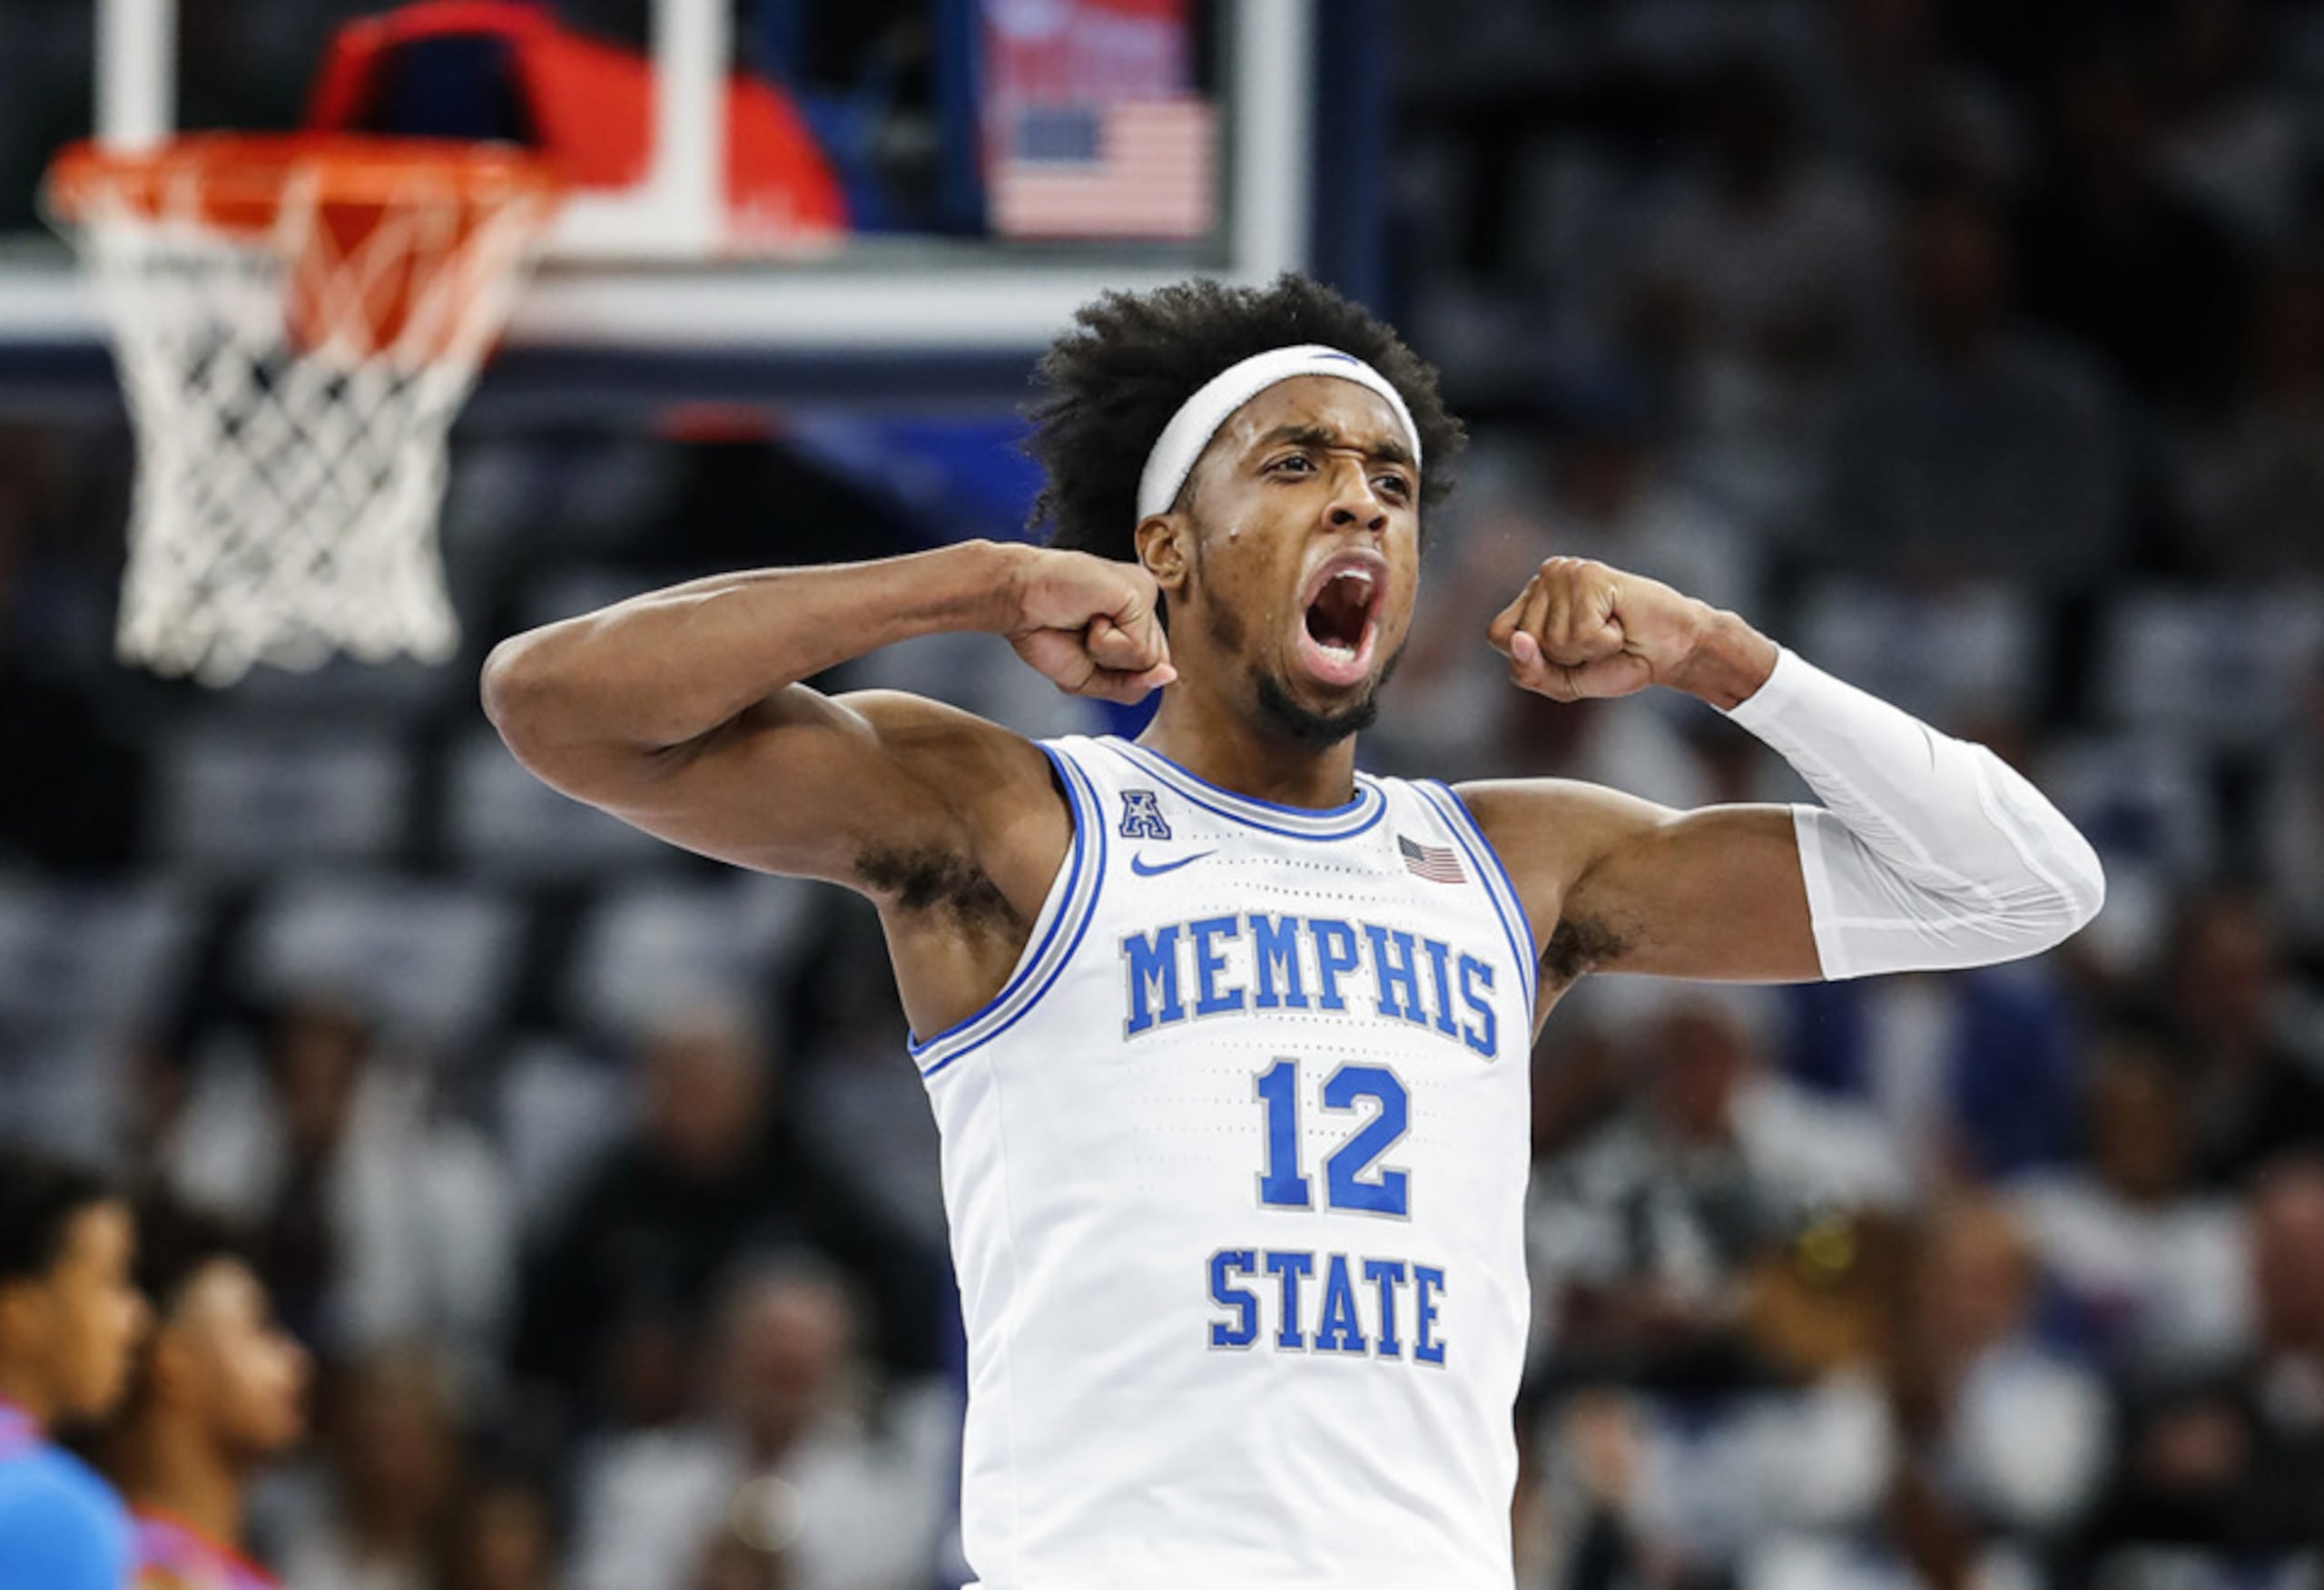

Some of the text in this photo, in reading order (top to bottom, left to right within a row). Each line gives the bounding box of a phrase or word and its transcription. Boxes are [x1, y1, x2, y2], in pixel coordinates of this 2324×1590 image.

[1120, 913, 1499, 1062] MEMPHIS
[1254, 1057, 1411, 1222] 12
[1206, 1248, 1446, 1369] STATE
